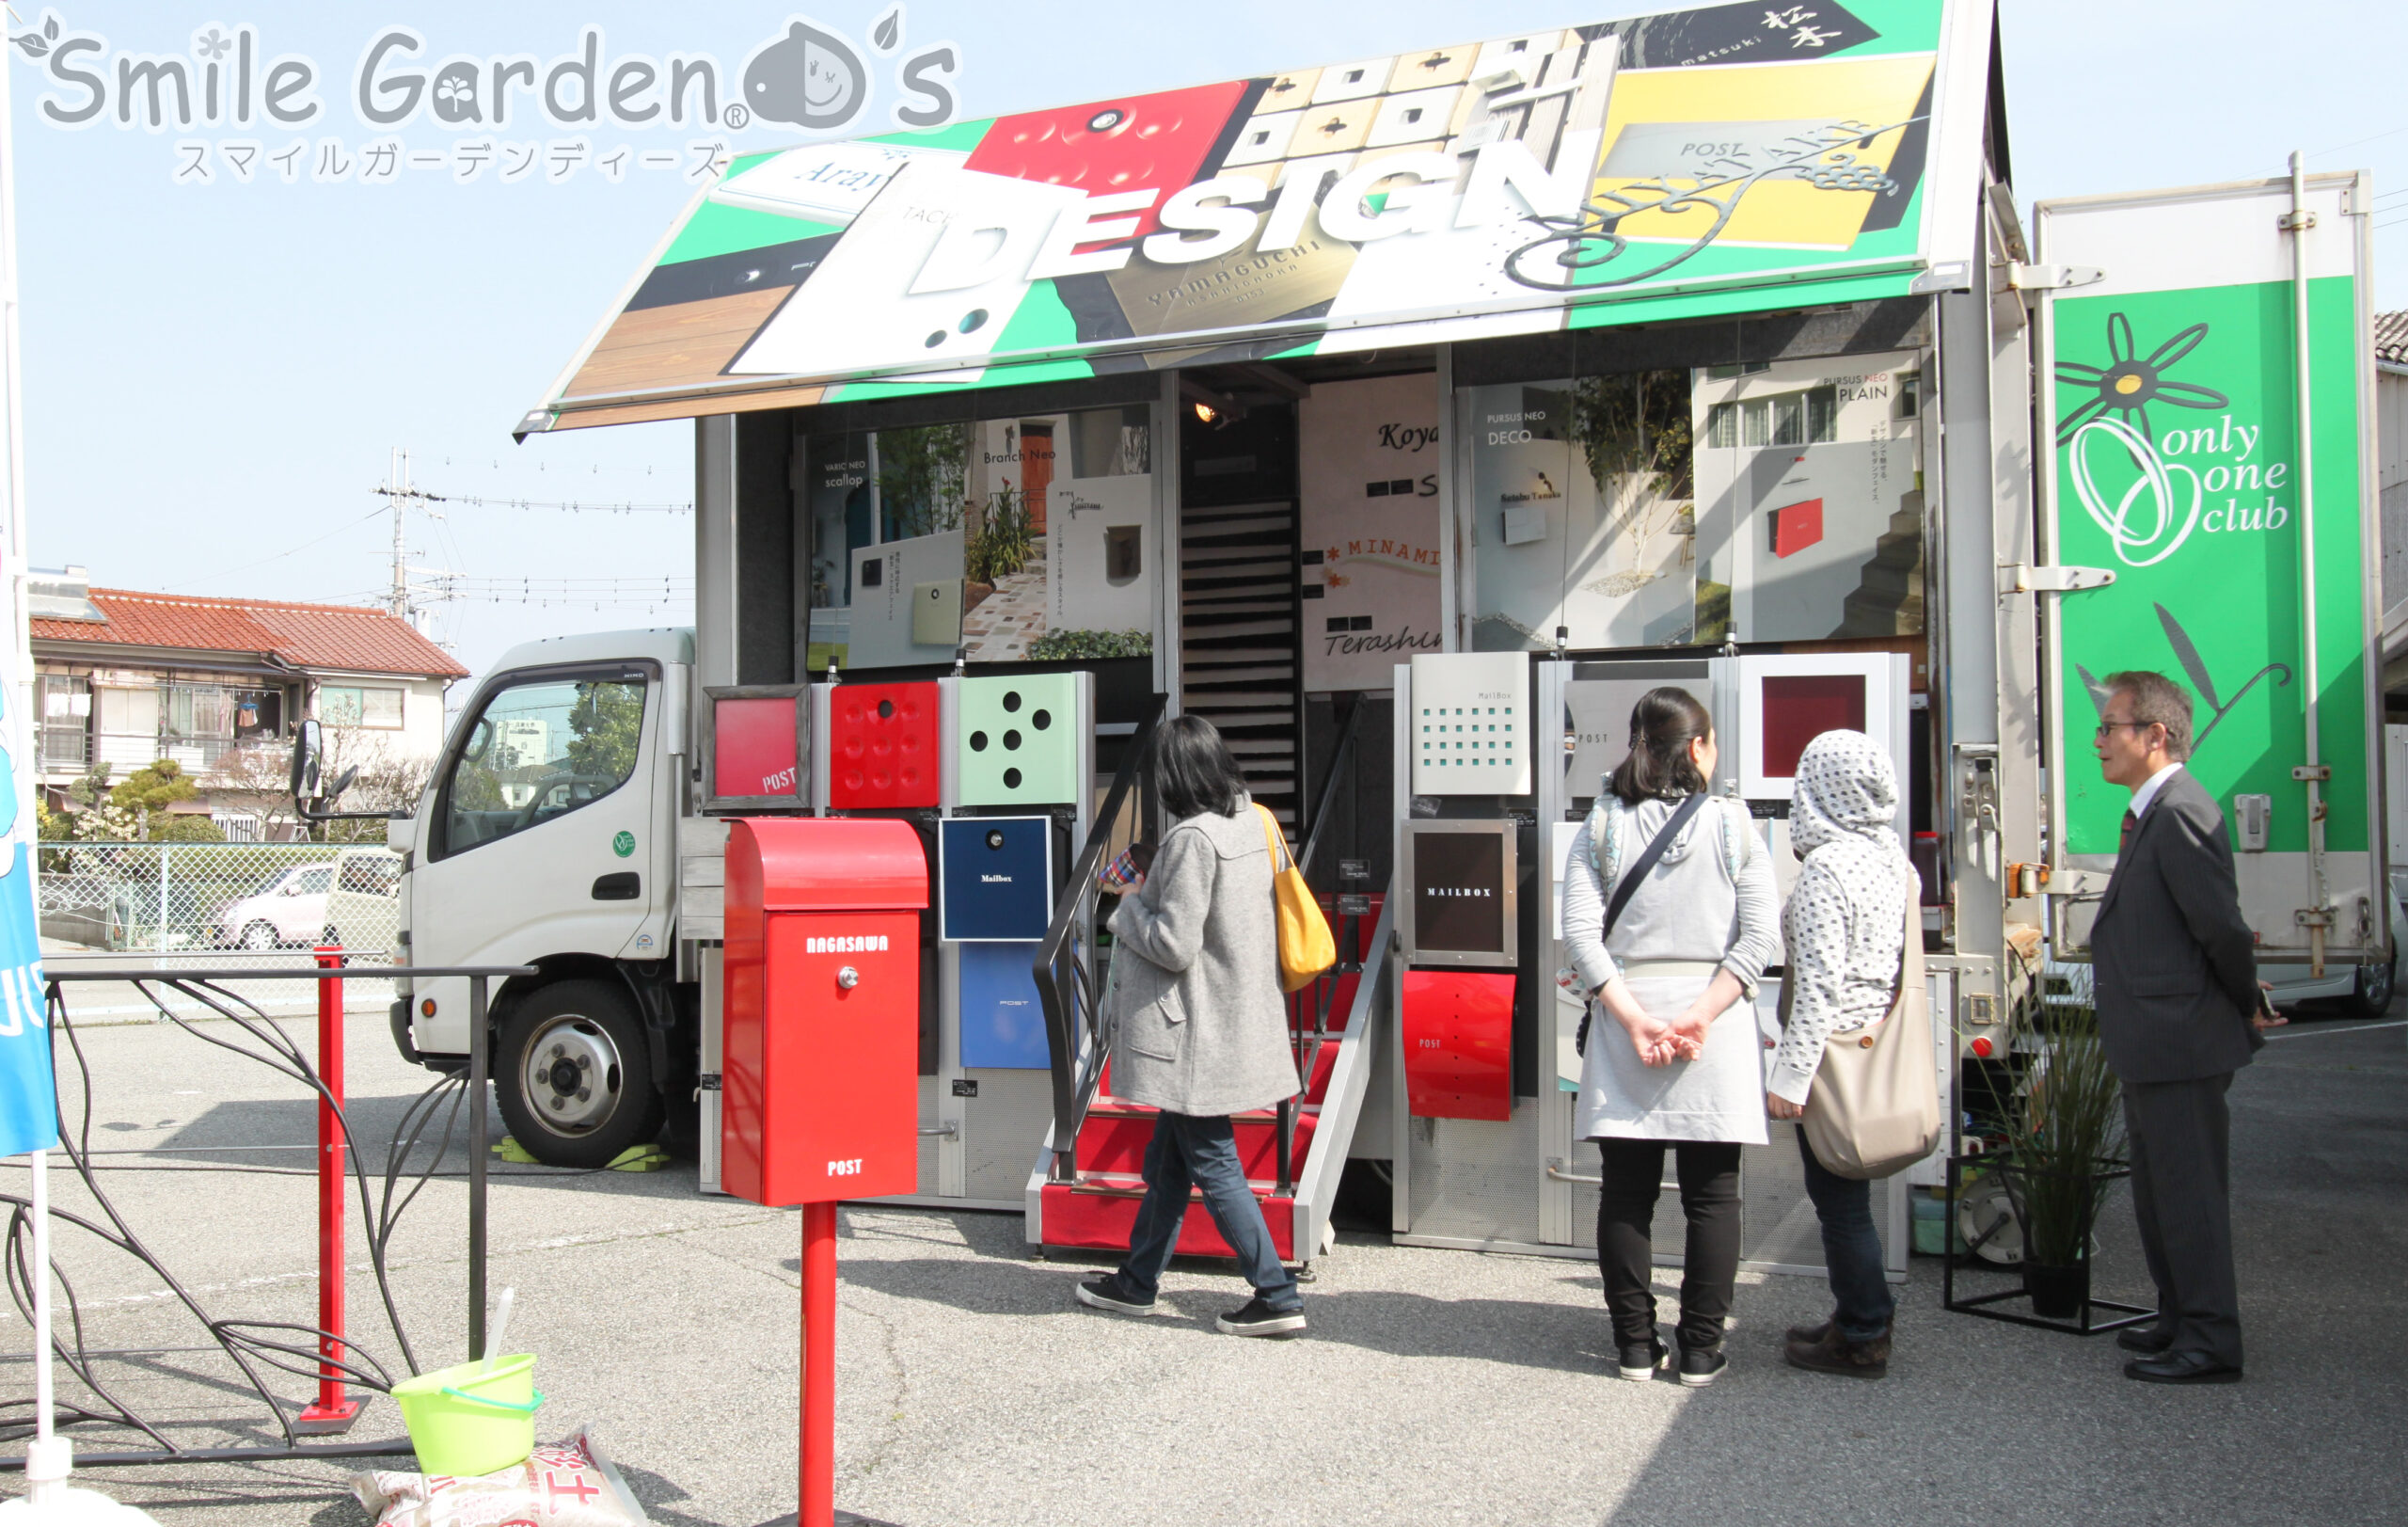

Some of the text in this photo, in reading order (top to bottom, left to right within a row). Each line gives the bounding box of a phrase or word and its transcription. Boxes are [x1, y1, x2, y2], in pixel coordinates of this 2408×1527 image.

[1681, 35, 1762, 67] matsuki
[1680, 143, 1743, 157] POST
[907, 128, 1601, 294] DESIGN
[1146, 240, 1322, 308] YAMAGUCHI
[1824, 373, 1888, 386] PURSUS NEO
[1839, 385, 1888, 402] PLAIN
[1487, 411, 1546, 423] PURSUS NEO
[1488, 430, 1532, 446] DECO
[2162, 414, 2258, 461] only
[848, 460, 865, 469] NEO
[984, 450, 1056, 464] Branch Neo
[825, 473, 863, 488] scallop
[2203, 462, 2287, 492] one
[2202, 497, 2288, 533] club
[1348, 539, 1441, 565] MINAMI
[1578, 734, 1608, 742] POST
[762, 768, 797, 793] POST
[1427, 887, 1490, 897] MAILBOX
[806, 935, 888, 953] NAGASAWA
[1419, 1039, 1441, 1048] POST
[828, 1158, 863, 1176] POST
